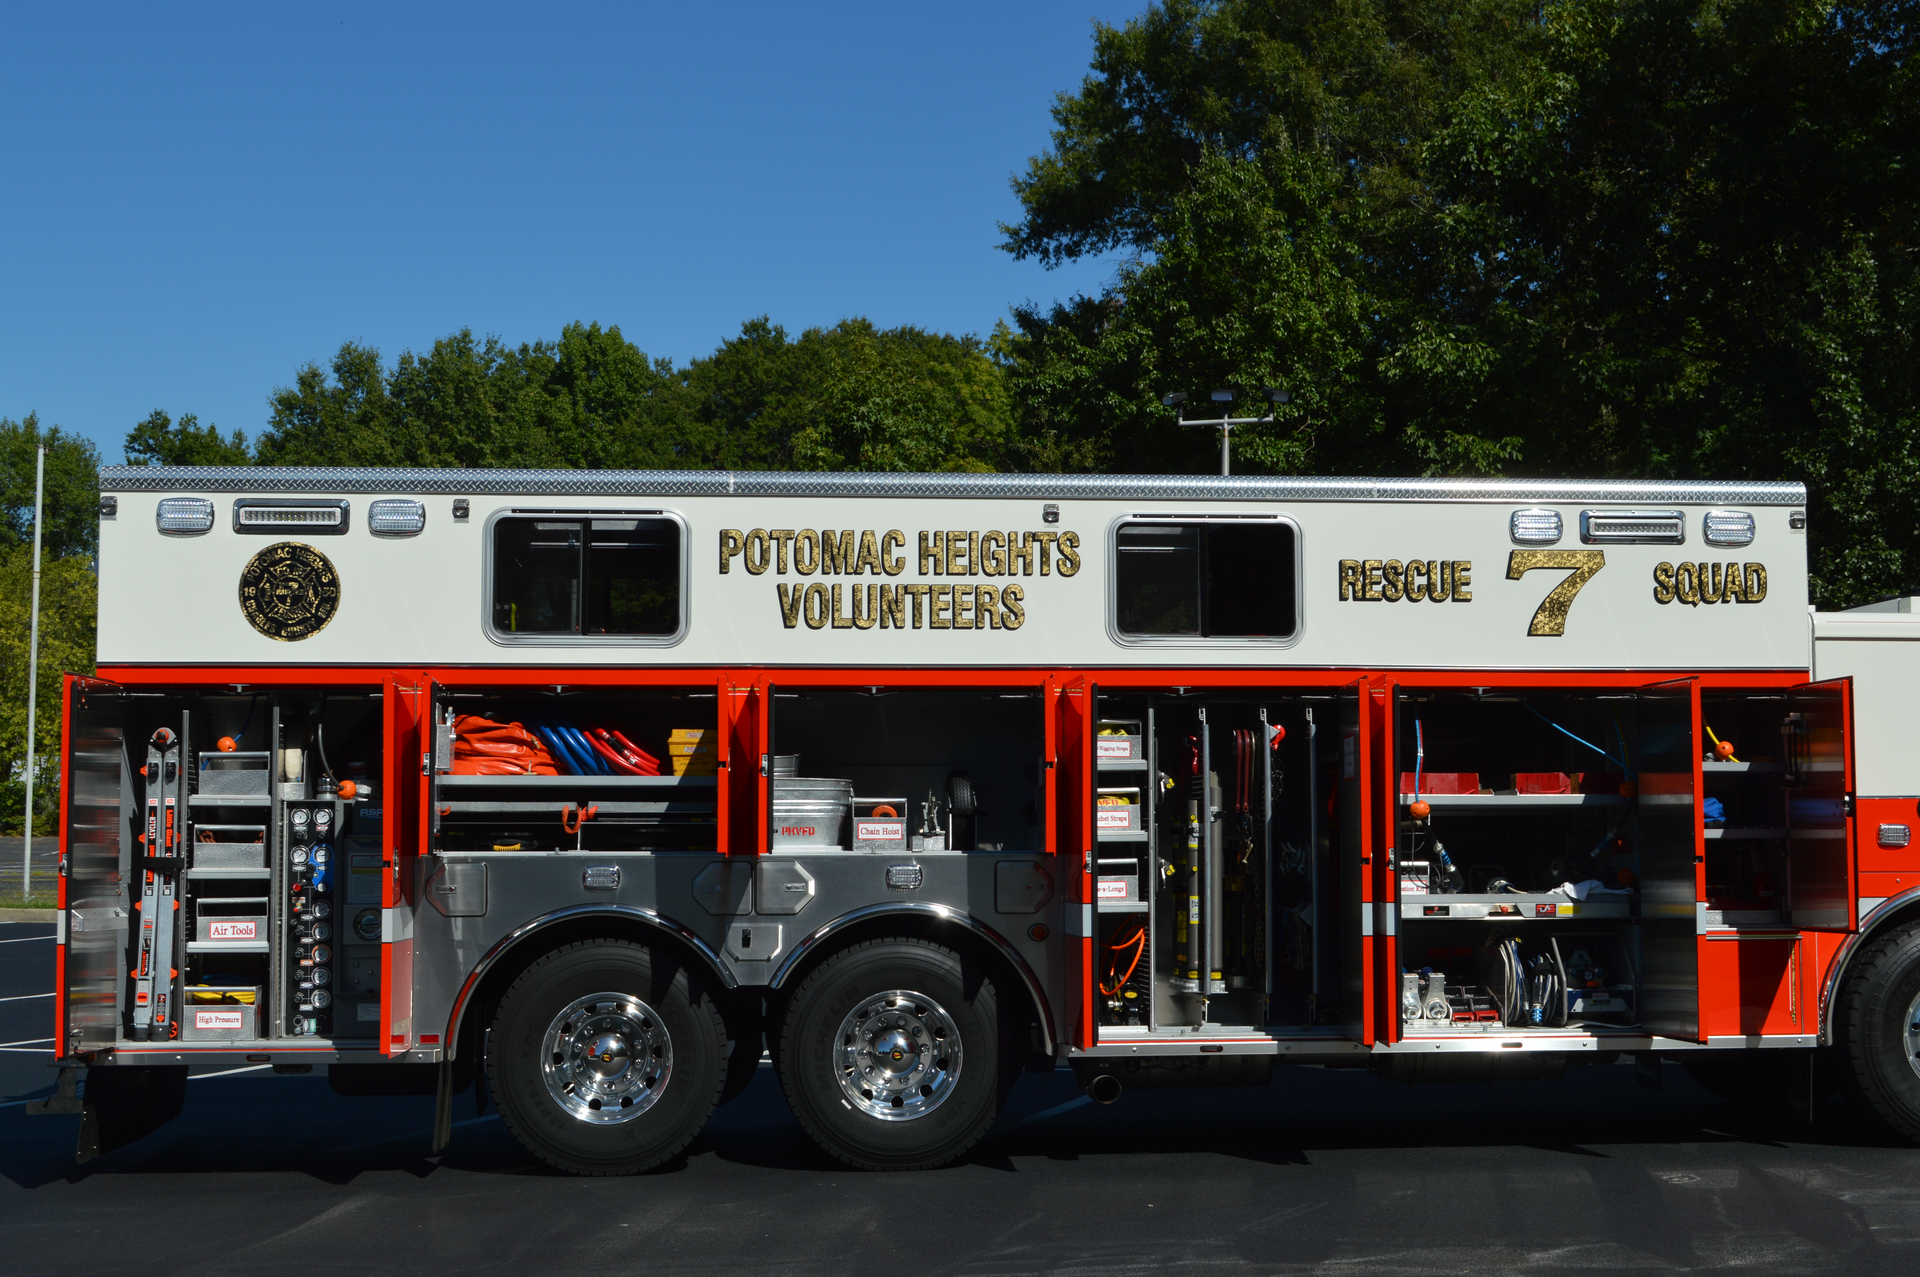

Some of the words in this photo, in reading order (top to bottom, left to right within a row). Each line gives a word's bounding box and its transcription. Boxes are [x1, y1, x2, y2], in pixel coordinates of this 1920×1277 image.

[246, 547, 292, 582] POTOMAC
[295, 548, 332, 582] HEIGHTS
[719, 529, 906, 576] POTOMAC
[918, 530, 1081, 577] HEIGHTS
[1338, 559, 1473, 603] RESCUE
[1505, 549, 1606, 637] 7
[1653, 561, 1768, 608] SQUAD
[776, 582, 1026, 630] VOLUNTEERS
[148, 816, 156, 839] LEVELER
[165, 809, 174, 828] Little
[781, 826, 815, 836] PHVFD
[860, 827, 880, 835] Chain
[882, 827, 900, 835] Hoist
[1110, 815, 1127, 823] Straps
[165, 828, 174, 847] Giant
[212, 925, 228, 936] Air
[230, 925, 253, 936] Tools
[198, 1015, 213, 1024] High
[662, 1000, 692, 1092] ICHELIN
[814, 984, 860, 1092] MICHELIN
